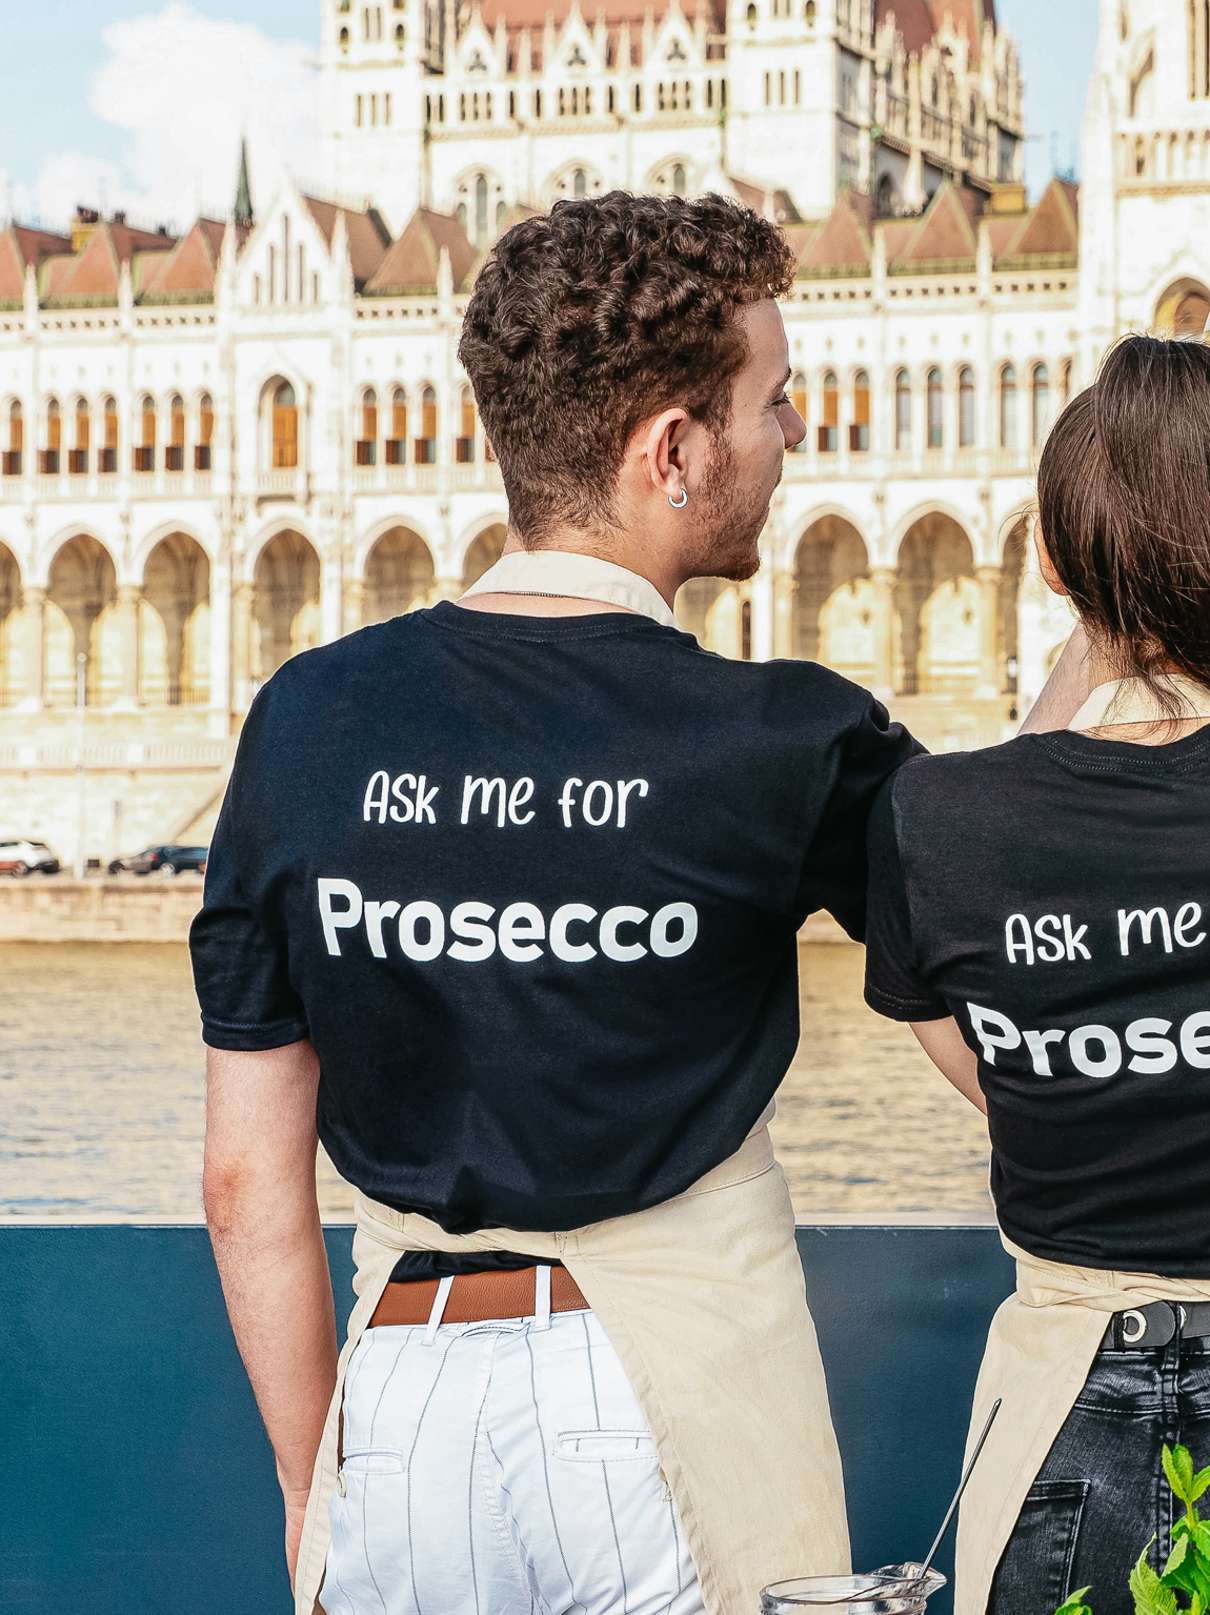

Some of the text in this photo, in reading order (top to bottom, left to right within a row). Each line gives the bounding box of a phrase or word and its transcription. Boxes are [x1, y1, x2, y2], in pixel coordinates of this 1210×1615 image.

[363, 770, 649, 829] Ask me for
[317, 877, 699, 963] Prosecco
[1004, 913, 1092, 966] Ask
[1117, 901, 1207, 956] me
